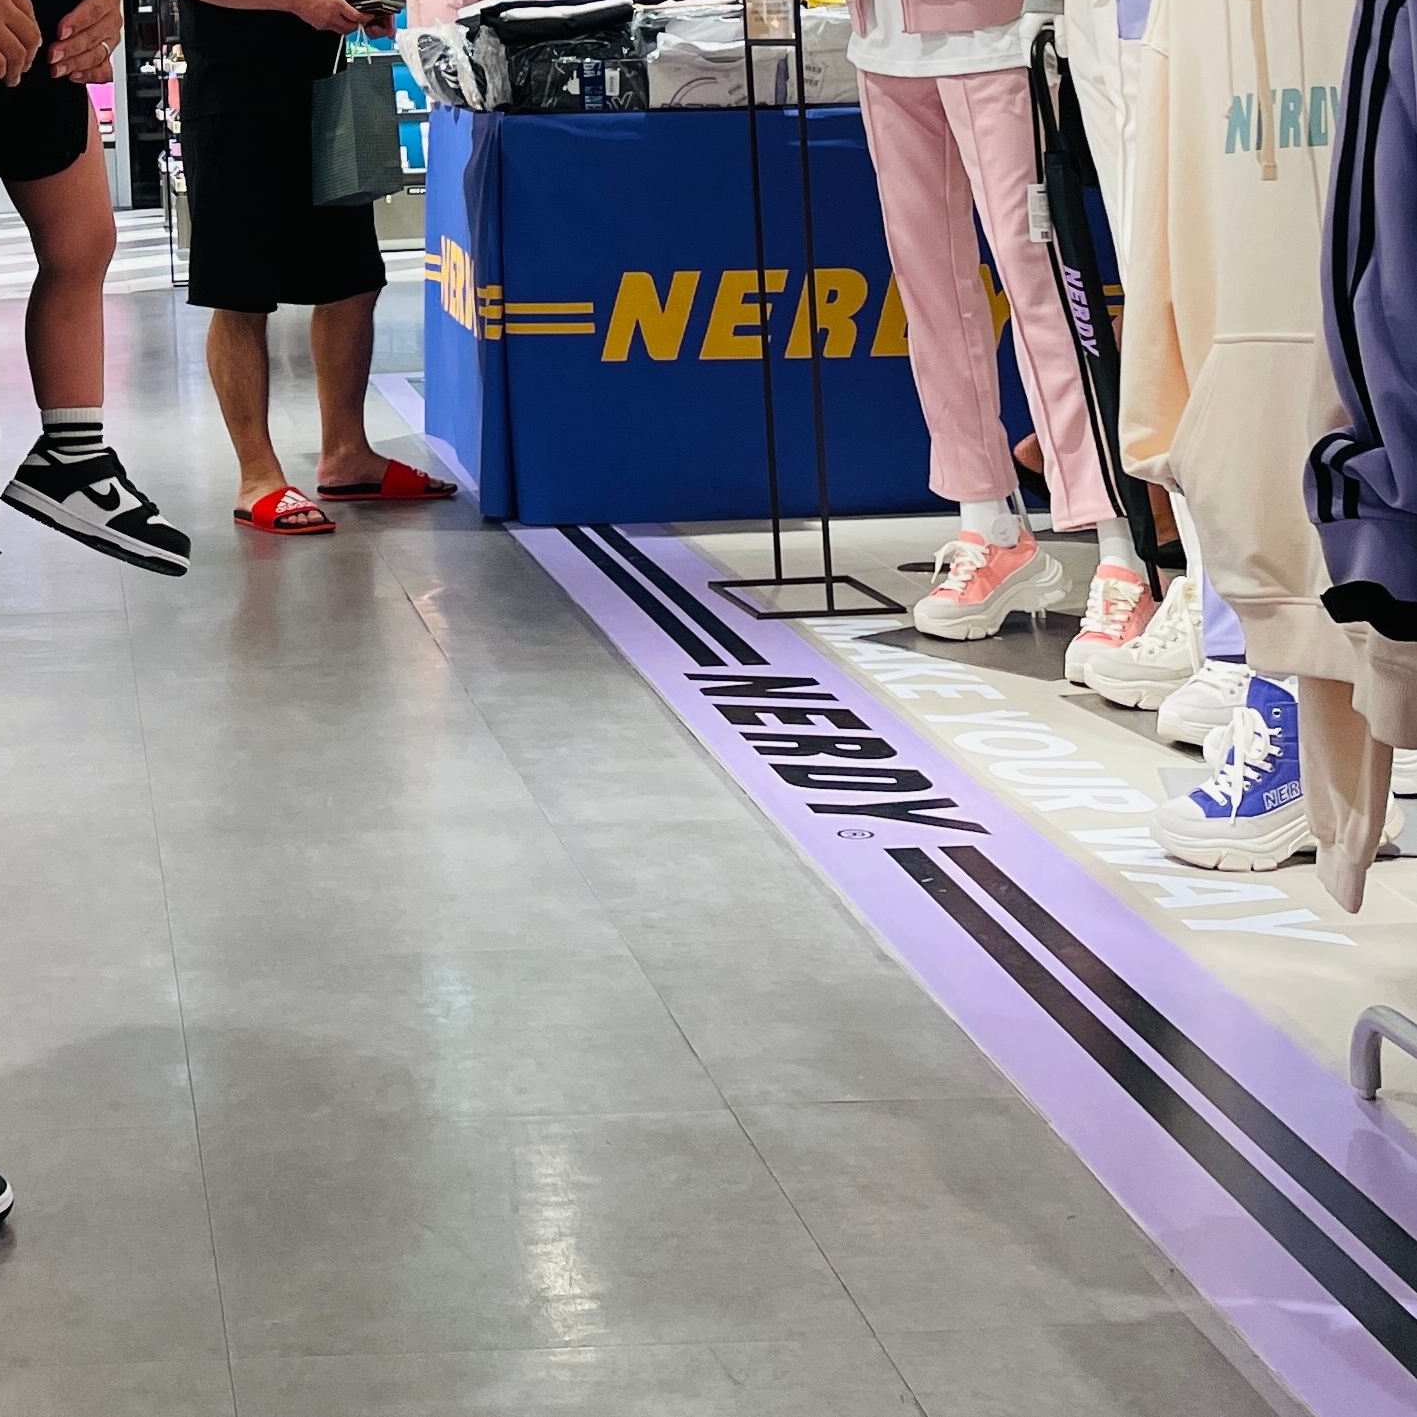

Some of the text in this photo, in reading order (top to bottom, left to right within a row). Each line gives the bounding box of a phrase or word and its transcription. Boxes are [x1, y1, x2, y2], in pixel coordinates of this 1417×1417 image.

[1063, 265, 1100, 357] NERDY
[684, 673, 993, 836] NERDY
[796, 618, 1008, 702] MAKE
[924, 709, 1159, 813] YOUR
[1263, 780, 1301, 811] NER
